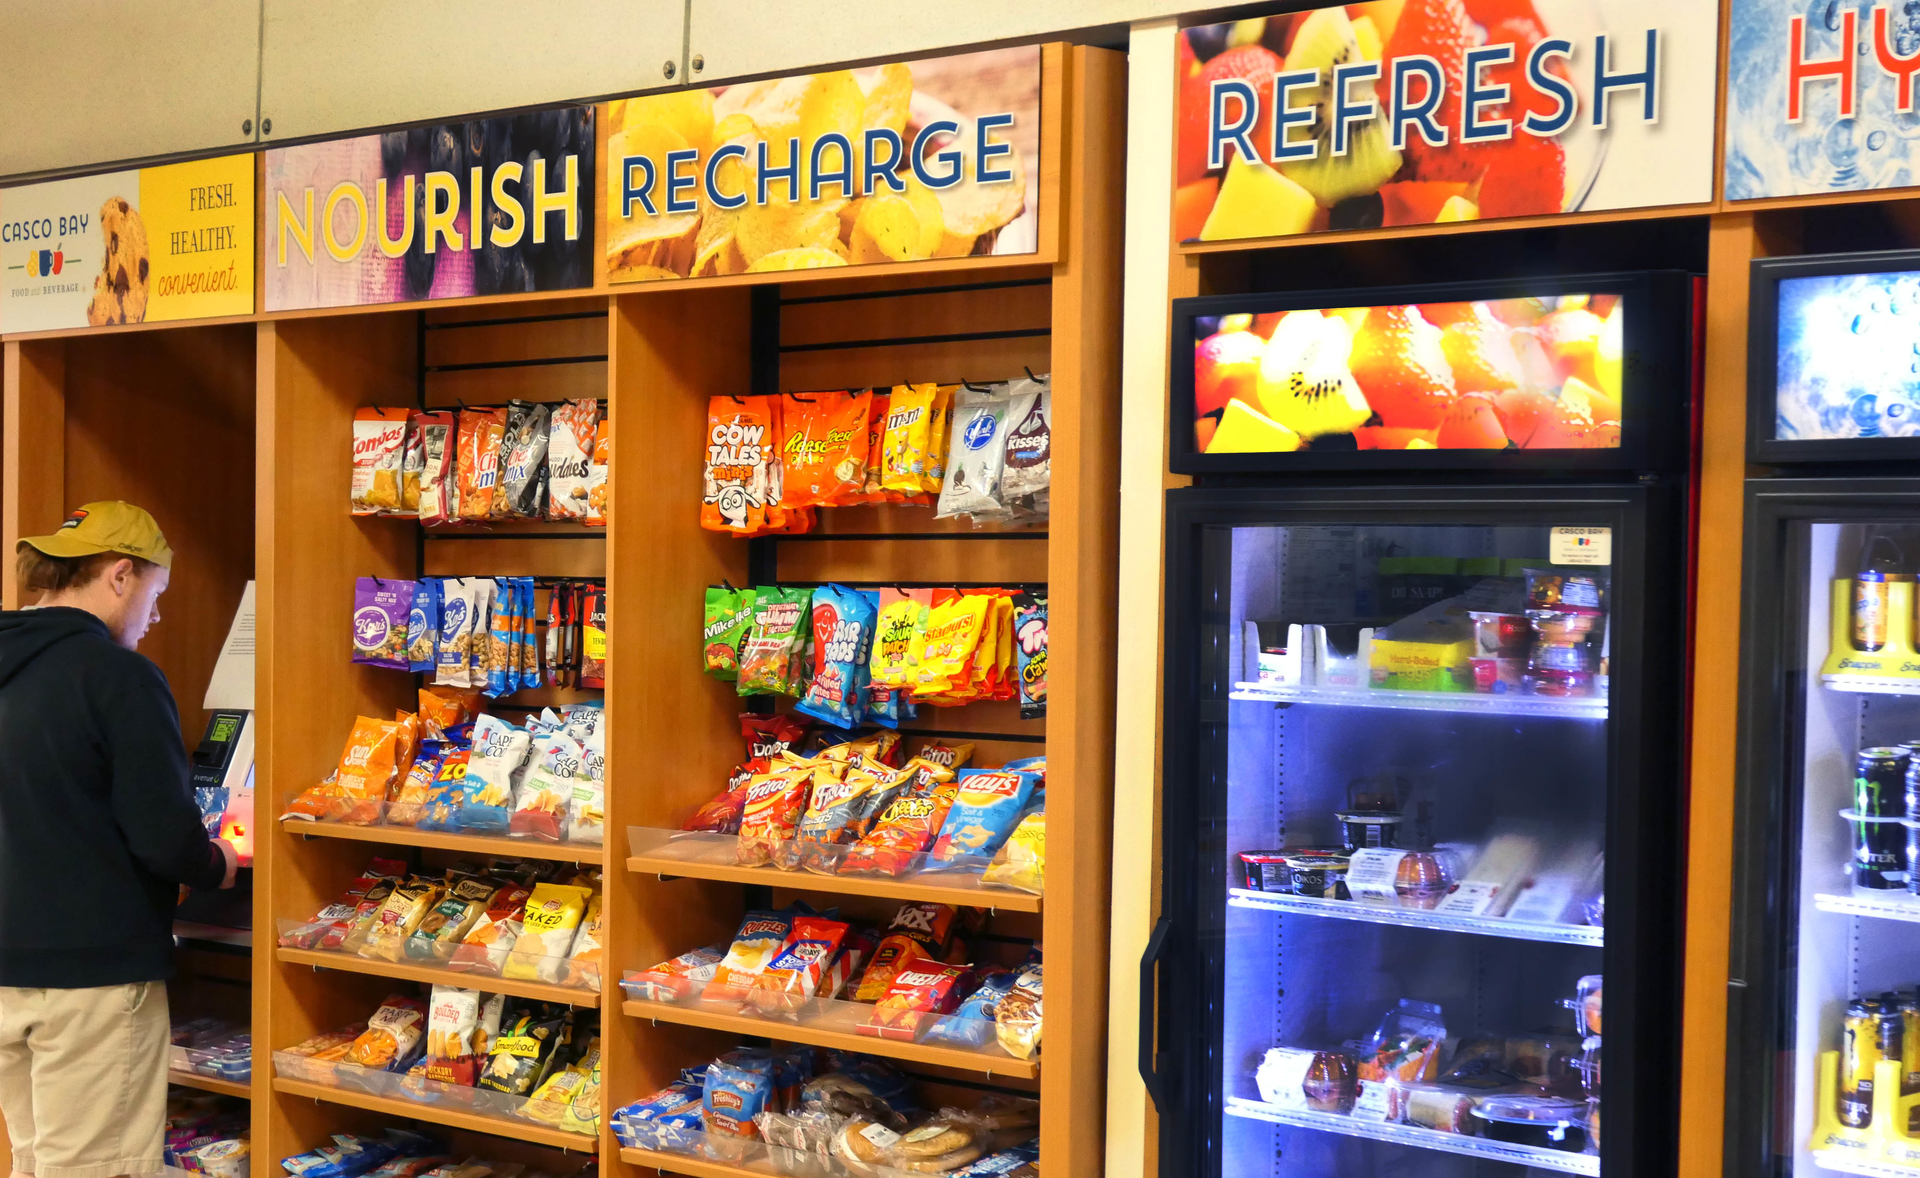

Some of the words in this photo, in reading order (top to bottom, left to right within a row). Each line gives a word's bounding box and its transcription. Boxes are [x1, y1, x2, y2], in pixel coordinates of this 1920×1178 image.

[1206, 27, 1660, 171] REFRESH
[621, 112, 1016, 219] RECHARGE
[189, 182, 237, 212] FRESH.
[275, 153, 580, 270] NOURISH
[2, 218, 52, 243] CASCO
[59, 213, 89, 236] BAY
[169, 225, 237, 256] HEALTHY.
[157, 259, 238, 298] convenient.
[11, 288, 30, 297] FOOD
[42, 283, 79, 295] BEVERAGE
[711, 424, 764, 445] COW
[708, 444, 761, 466] TALES
[713, 465, 754, 481] minis
[704, 620, 735, 640] Mike
[734, 607, 752, 624] Ike
[833, 619, 862, 642] AIR
[885, 626, 912, 641] SOUR
[882, 639, 909, 657] PATCH
[1030, 651, 1047, 666] SOUR
[745, 778, 791, 805] Fritos
[959, 772, 1019, 794] Lay's
[878, 798, 936, 823] Cheetos
[961, 807, 975, 817] Salt
[1010, 827, 1046, 842] Classic
[1298, 873, 1323, 885] OIKOS
[739, 920, 788, 937] RUFFLES
[727, 972, 755, 986] CHEDDAR
[379, 1015, 399, 1024] MIX
[380, 1007, 415, 1019] PARTY
[433, 1006, 460, 1025] BOULDER
[492, 1039, 537, 1053] Smartfood
[428, 1065, 453, 1076] HICKORY
[716, 1118, 729, 1128] Swirl
